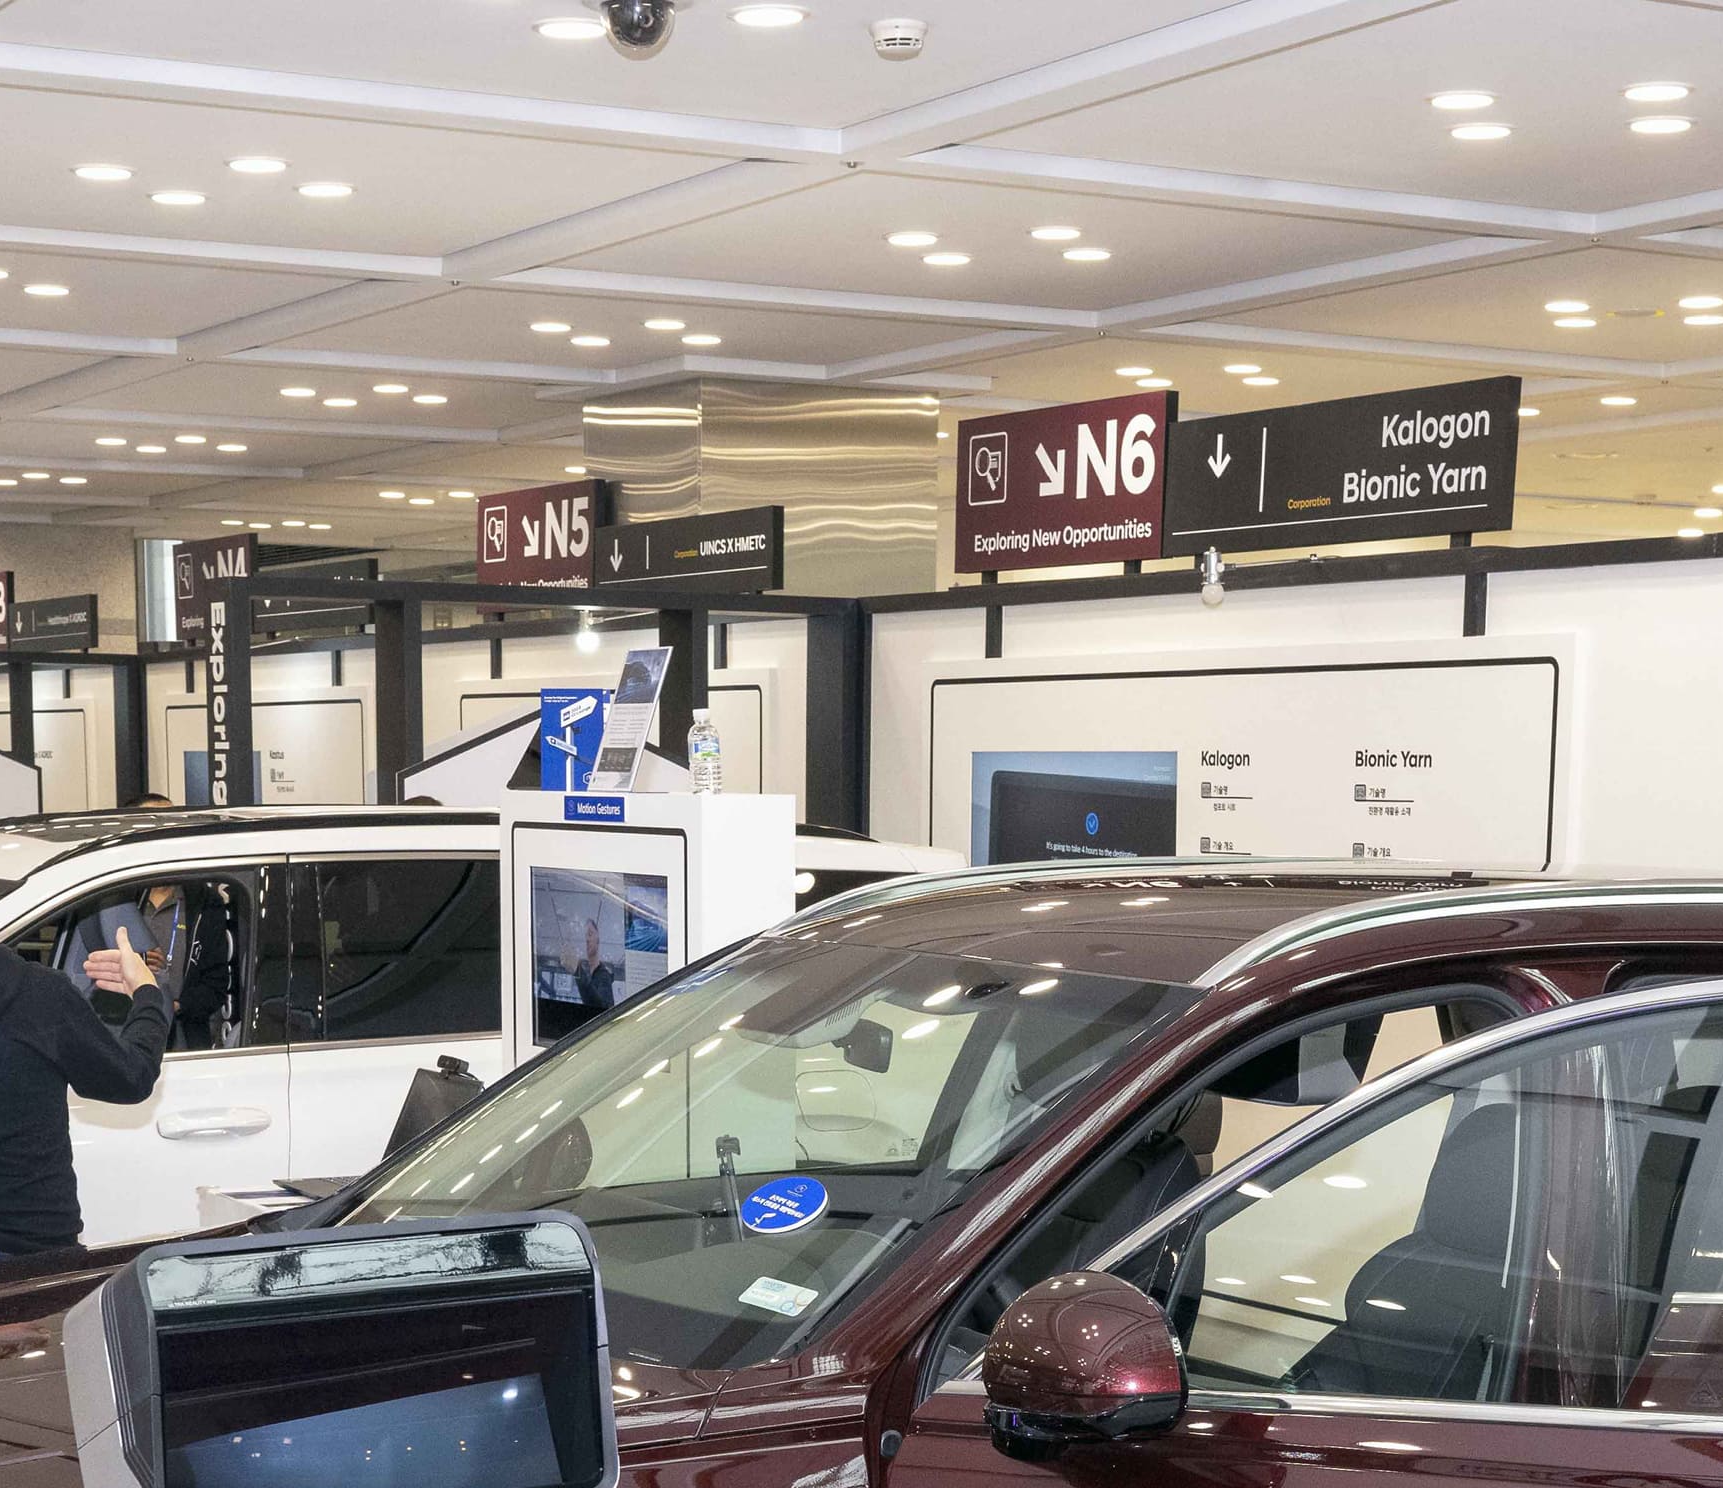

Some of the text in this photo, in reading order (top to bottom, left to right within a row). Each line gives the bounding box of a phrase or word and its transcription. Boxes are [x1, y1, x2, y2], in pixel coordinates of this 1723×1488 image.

[1381, 408, 1490, 451] Kalogon
[1077, 413, 1156, 499] N6
[1342, 462, 1487, 504] Bionic Yarn
[1287, 494, 1331, 510] Corporation
[544, 496, 589, 560] N5
[974, 519, 1152, 556] Exploring New Opportunities
[700, 533, 766, 556] UINCS X HMETC
[181, 615, 204, 630] Exploring
[210, 601, 230, 805] Exploring
[1200, 750, 1250, 769] Kalogon
[1355, 749, 1432, 768] Bionic Yarn
[577, 802, 596, 814] Motion
